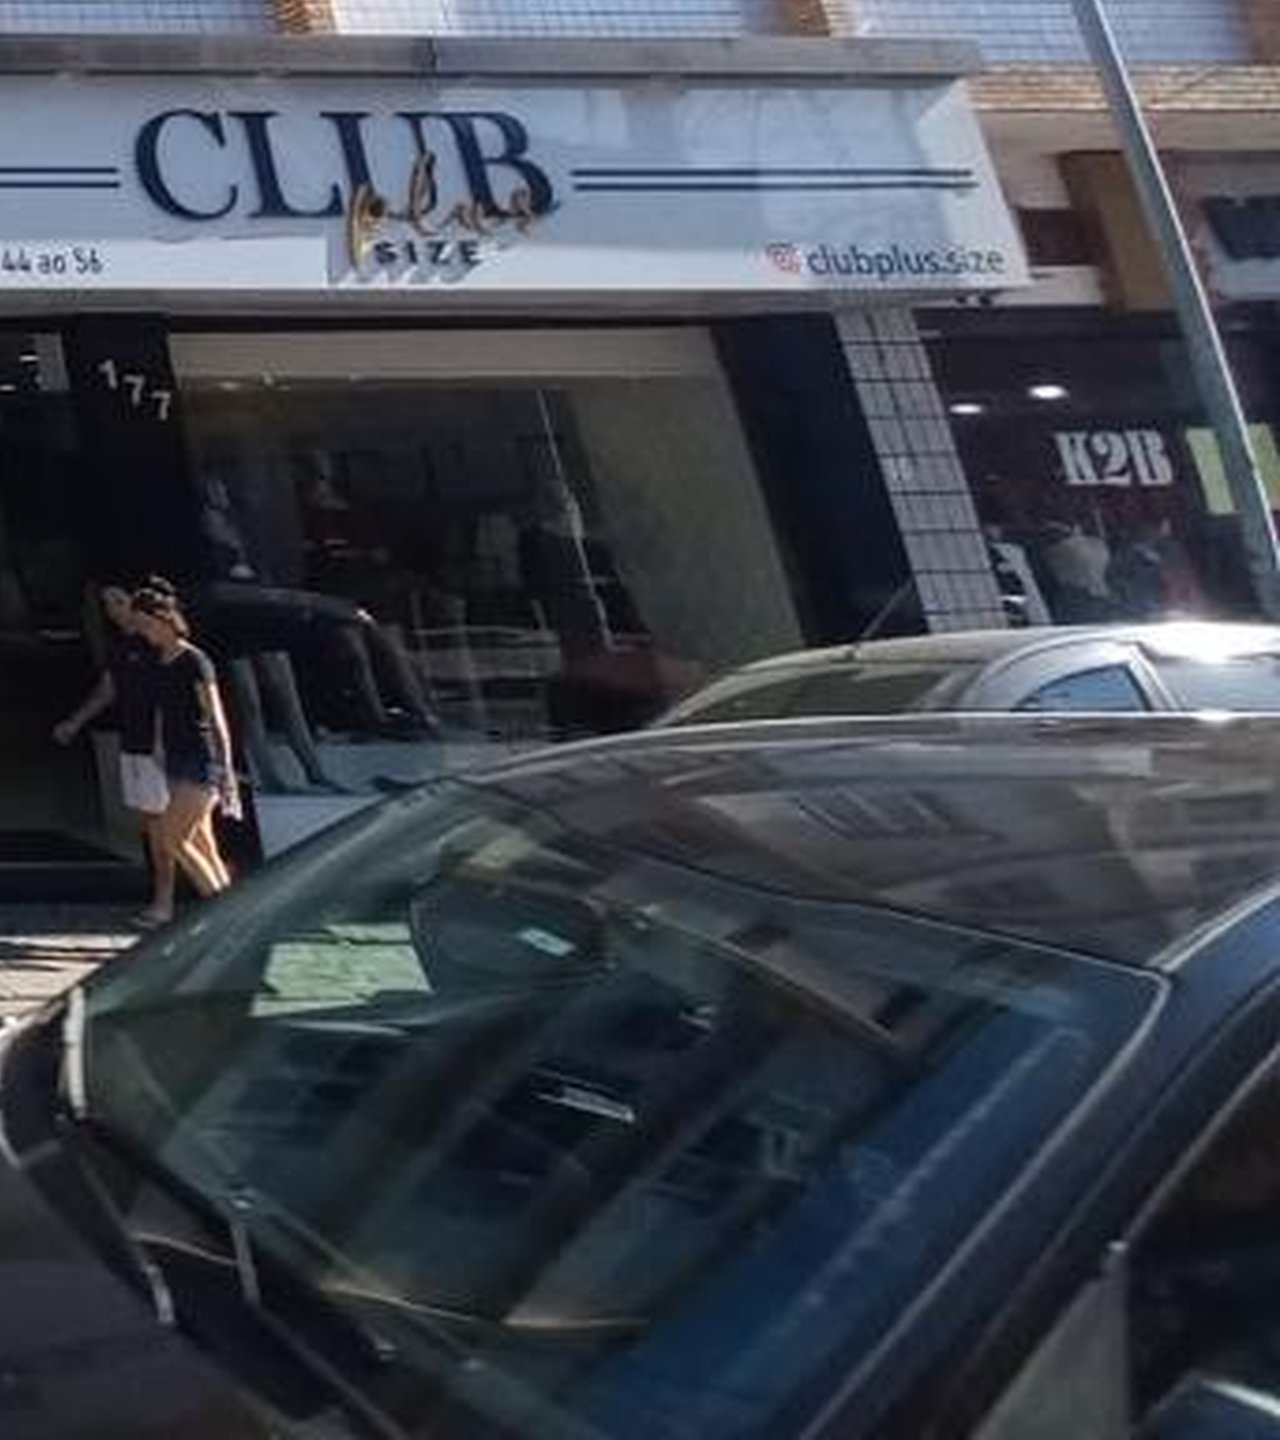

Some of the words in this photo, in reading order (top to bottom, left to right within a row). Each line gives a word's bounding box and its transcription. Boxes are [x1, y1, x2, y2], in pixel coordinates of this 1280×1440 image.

[134, 108, 560, 222] CLUB
[0, 248, 31, 273] 44
[38, 250, 67, 274] ao
[374, 240, 482, 266] SIZE
[806, 242, 1006, 283] clubplus.size
[99, 359, 172, 421] 177
